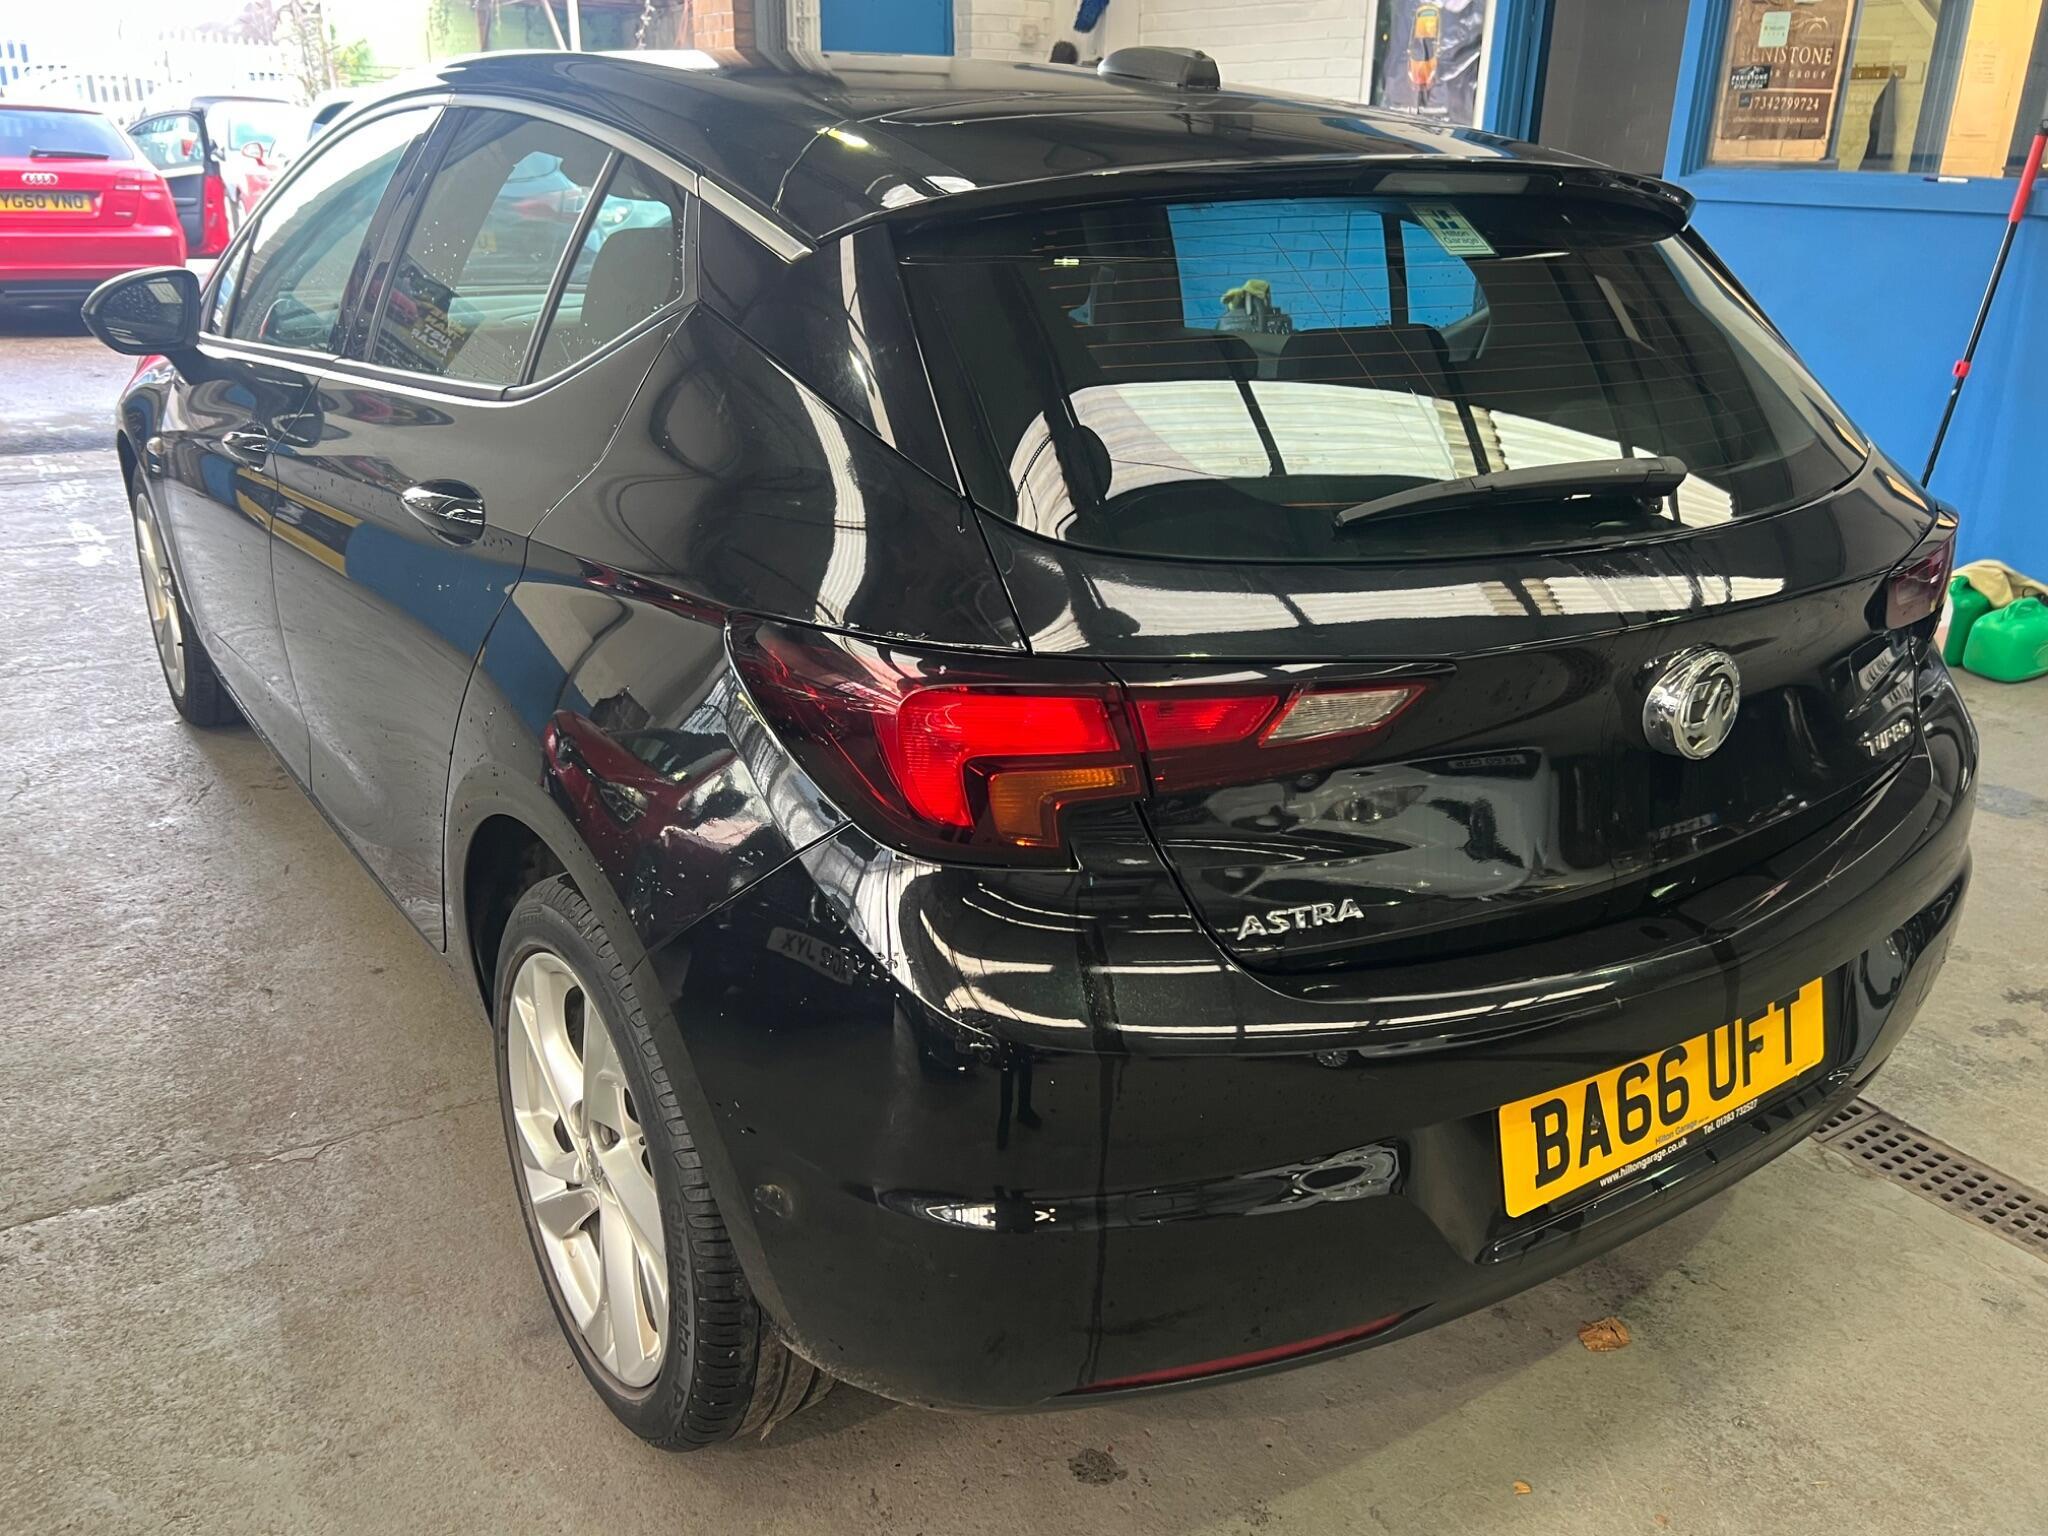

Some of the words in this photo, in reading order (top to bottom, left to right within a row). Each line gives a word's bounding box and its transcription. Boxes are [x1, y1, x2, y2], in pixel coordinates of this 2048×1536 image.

[1236, 898, 1365, 941] ASTRA
[1530, 1045, 1690, 1190] BA66
[1706, 989, 1801, 1102] UFT
[1655, 1130, 1675, 1146] Hilton
[1675, 1119, 1698, 1139] Garage
[1703, 1122, 1716, 1136] Tel.
[1599, 1137, 1688, 1188] www.hiltongarage.co.uk
